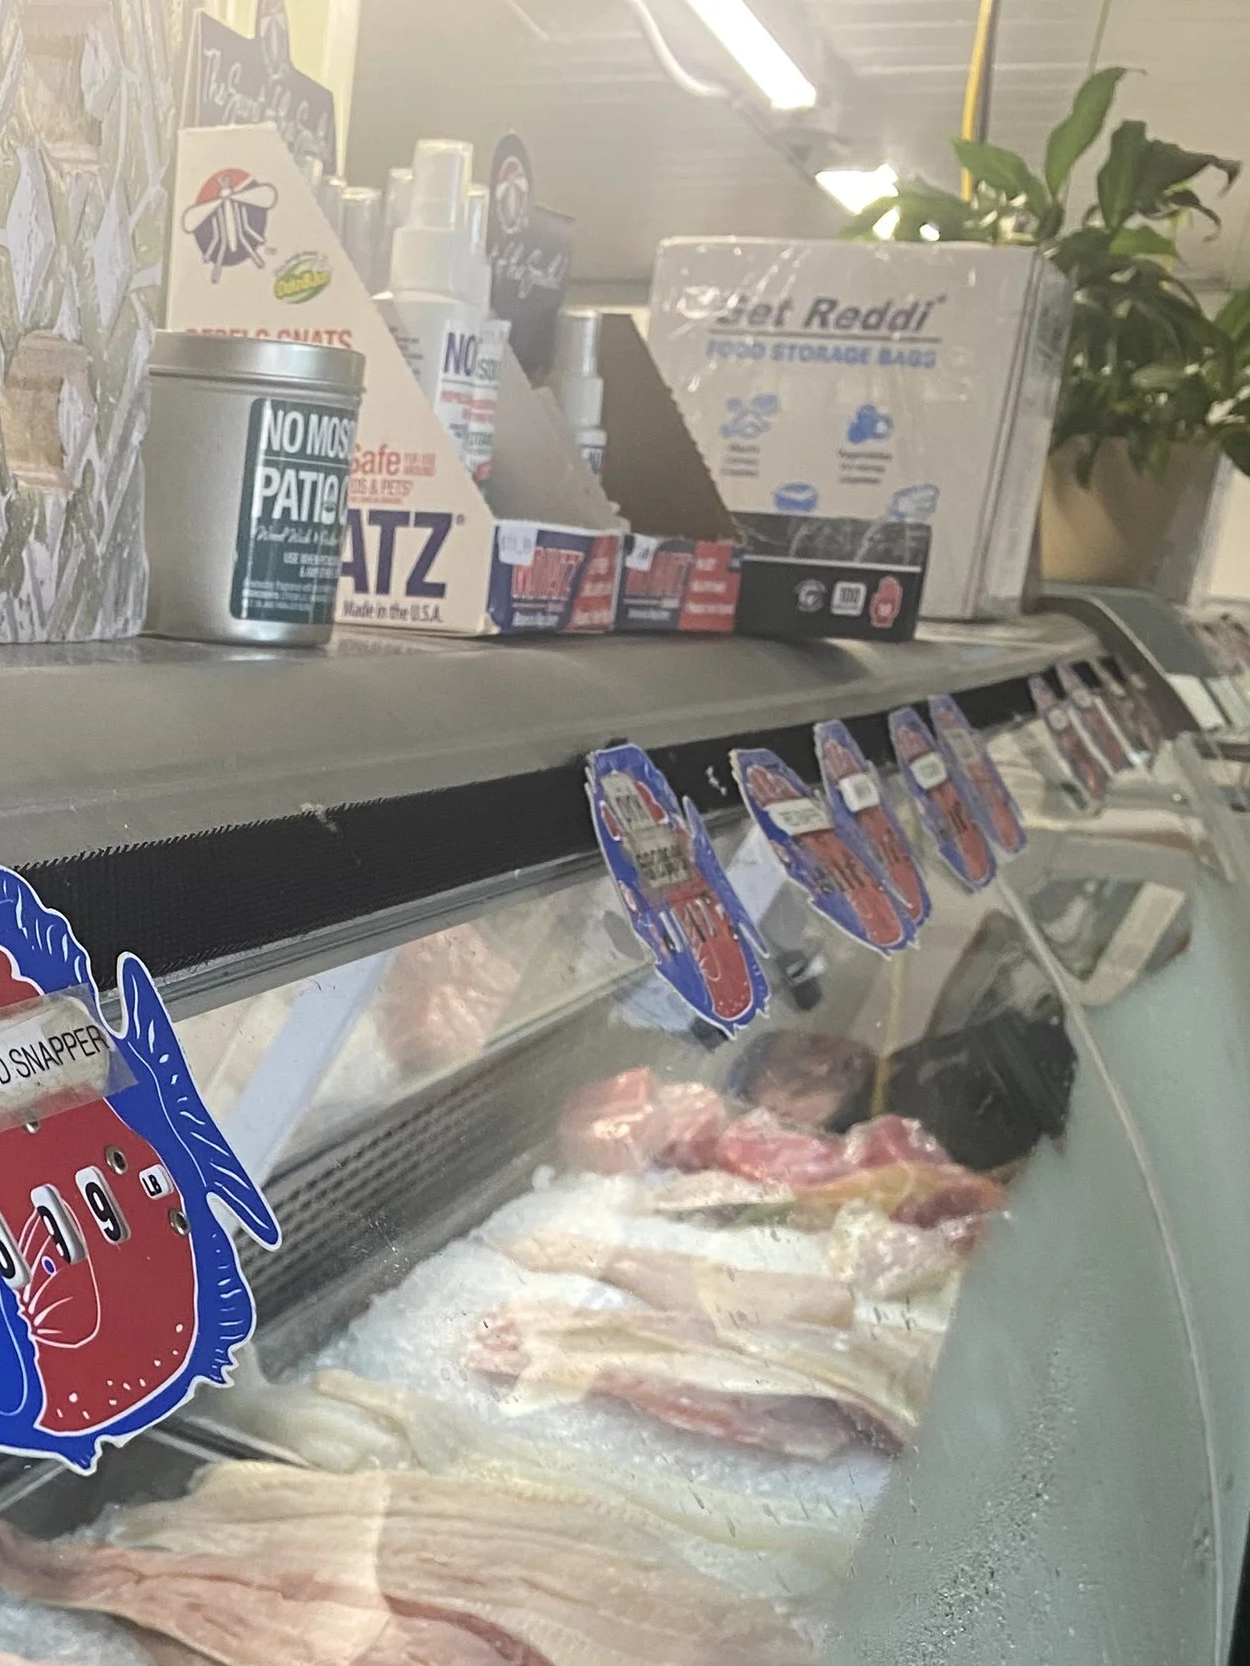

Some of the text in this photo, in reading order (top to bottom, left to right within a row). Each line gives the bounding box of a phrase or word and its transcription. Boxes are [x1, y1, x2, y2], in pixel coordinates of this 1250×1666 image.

[803, 295, 935, 332] Reddi
[770, 341, 871, 366] STORAGE
[877, 346, 937, 370] BAGS
[260, 403, 305, 454] NO
[251, 465, 340, 525] PATIO
[343, 601, 373, 619] Made
[376, 602, 387, 619] in
[389, 602, 408, 621] the
[8, 1024, 111, 1079] SNAPPER
